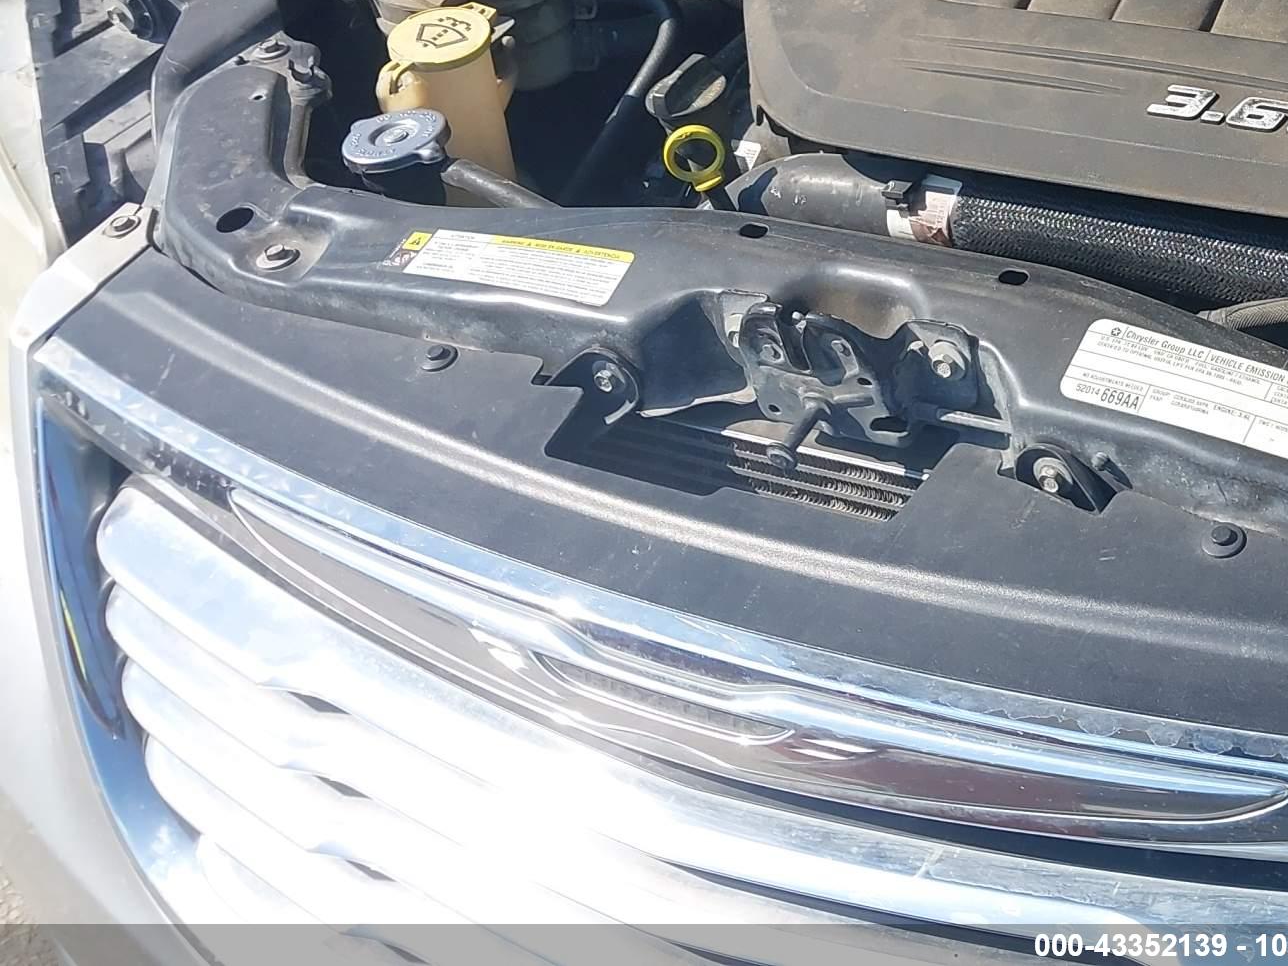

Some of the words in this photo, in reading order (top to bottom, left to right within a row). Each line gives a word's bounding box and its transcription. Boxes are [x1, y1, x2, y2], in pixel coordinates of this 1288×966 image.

[1124, 329, 1160, 347] Chrysler
[1159, 339, 1186, 355] Group
[1186, 347, 1205, 359] LLC
[1210, 354, 1244, 369] VEHICLE
[1244, 363, 1285, 382] EMISSION
[1074, 382, 1101, 397] 52014
[1099, 386, 1141, 411] 669AA
